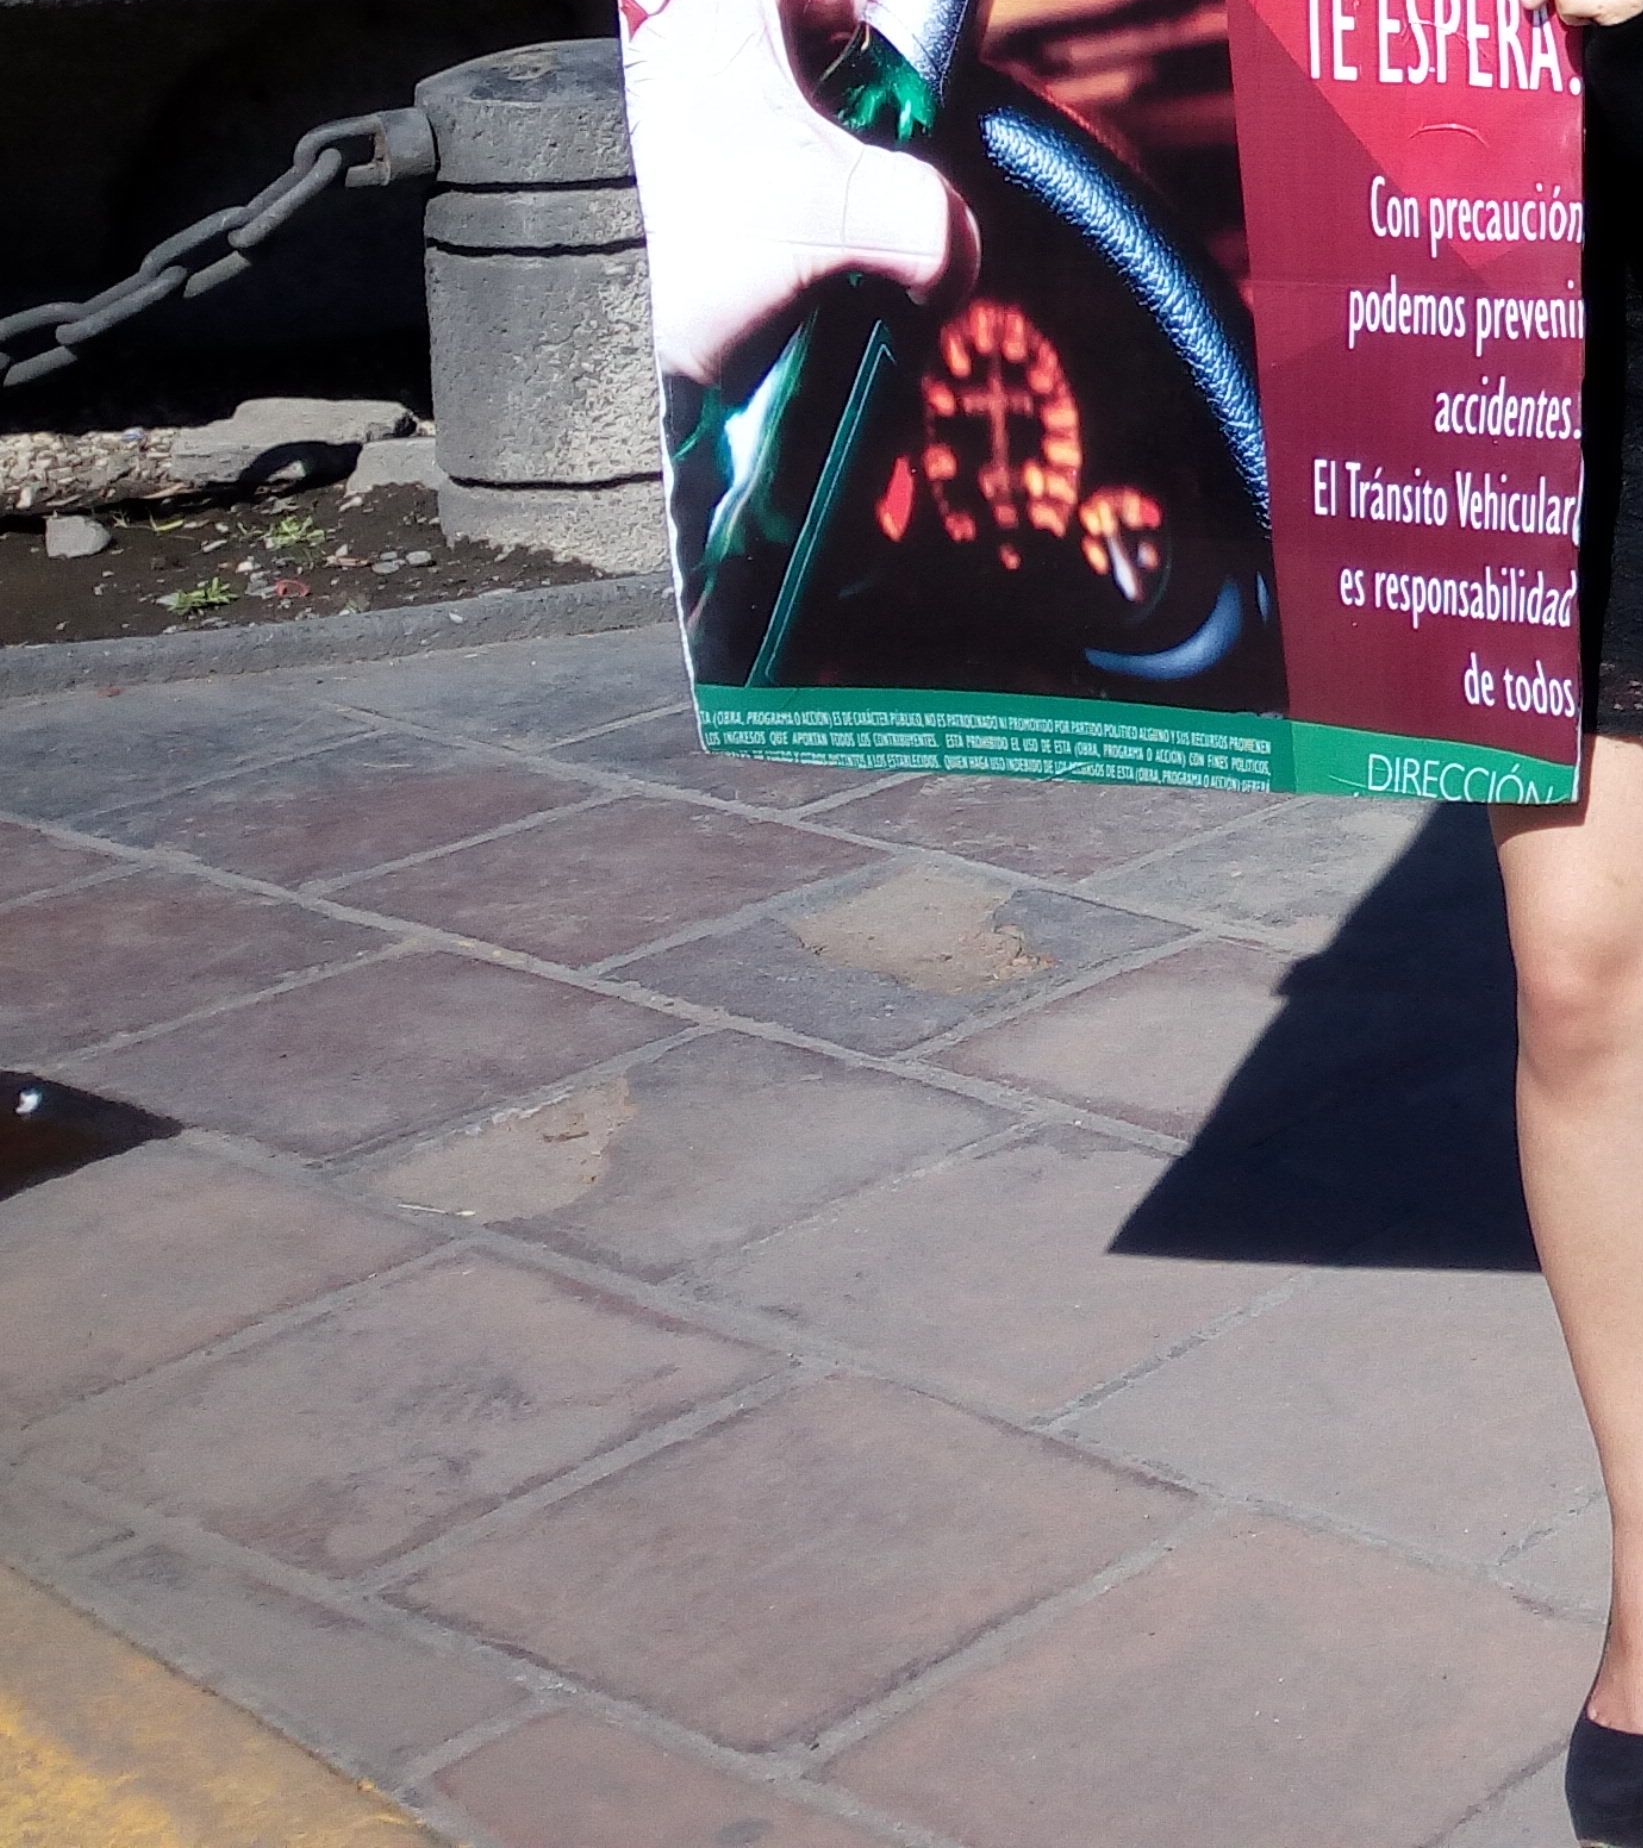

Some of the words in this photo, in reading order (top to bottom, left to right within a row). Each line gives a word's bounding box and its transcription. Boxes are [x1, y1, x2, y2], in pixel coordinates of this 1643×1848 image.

[1370, 176, 1420, 240] Con
[1428, 183, 1583, 258] precaución
[1349, 275, 1466, 349] podemos
[1476, 279, 1585, 358] prevenir
[1434, 375, 1582, 441] accidentes.
[1313, 458, 1336, 517] El
[1346, 459, 1448, 527] Tránsito
[1456, 471, 1577, 537] Vehicular
[1340, 567, 1364, 607] es
[1374, 564, 1577, 629] responsabilidad
[1463, 652, 1496, 708] de
[1503, 659, 1576, 719] todos
[1368, 753, 1553, 805] DIRECCIÓN
